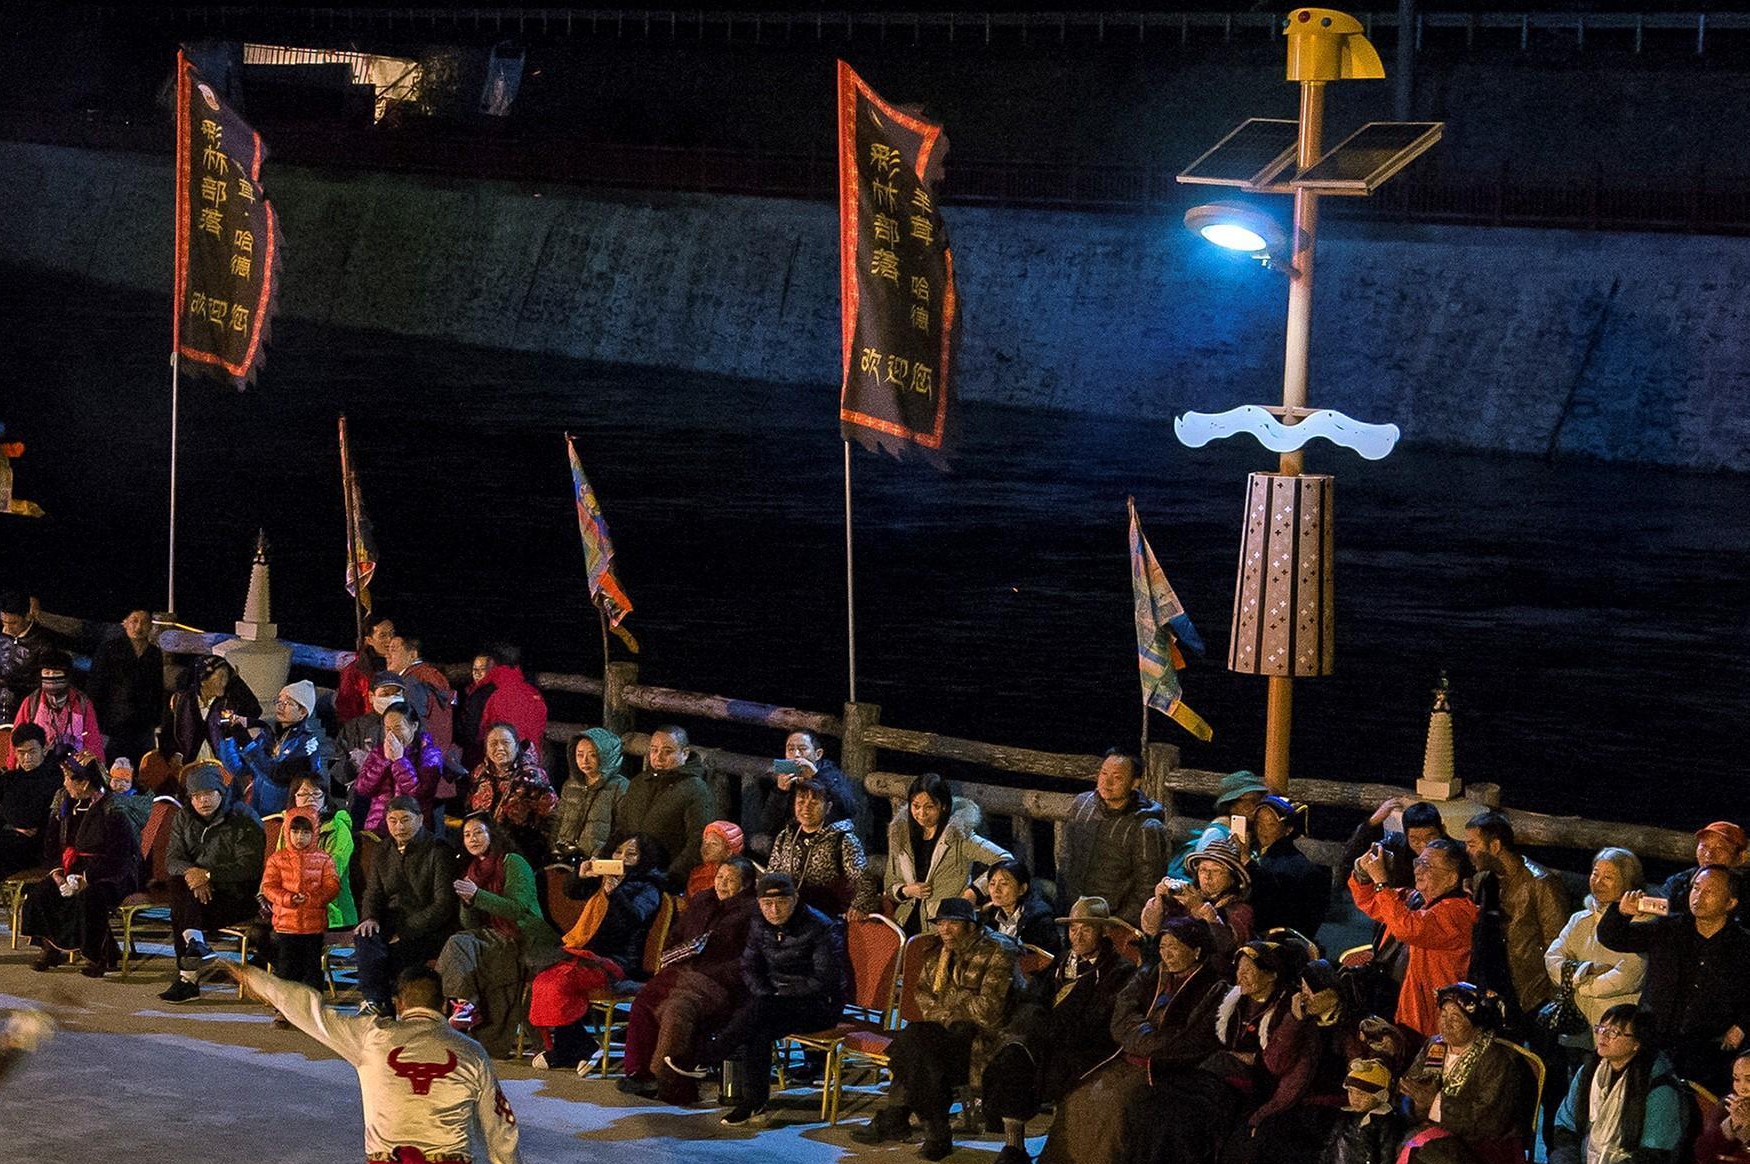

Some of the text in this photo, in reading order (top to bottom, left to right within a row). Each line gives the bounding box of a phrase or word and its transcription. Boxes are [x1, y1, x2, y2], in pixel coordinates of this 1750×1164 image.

[199, 118, 229, 241] 彩林部落
[229, 165, 256, 281] 茸·哈德
[190, 291, 250, 338] 欢迎您
[860, 346, 933, 401] 欢迎您
